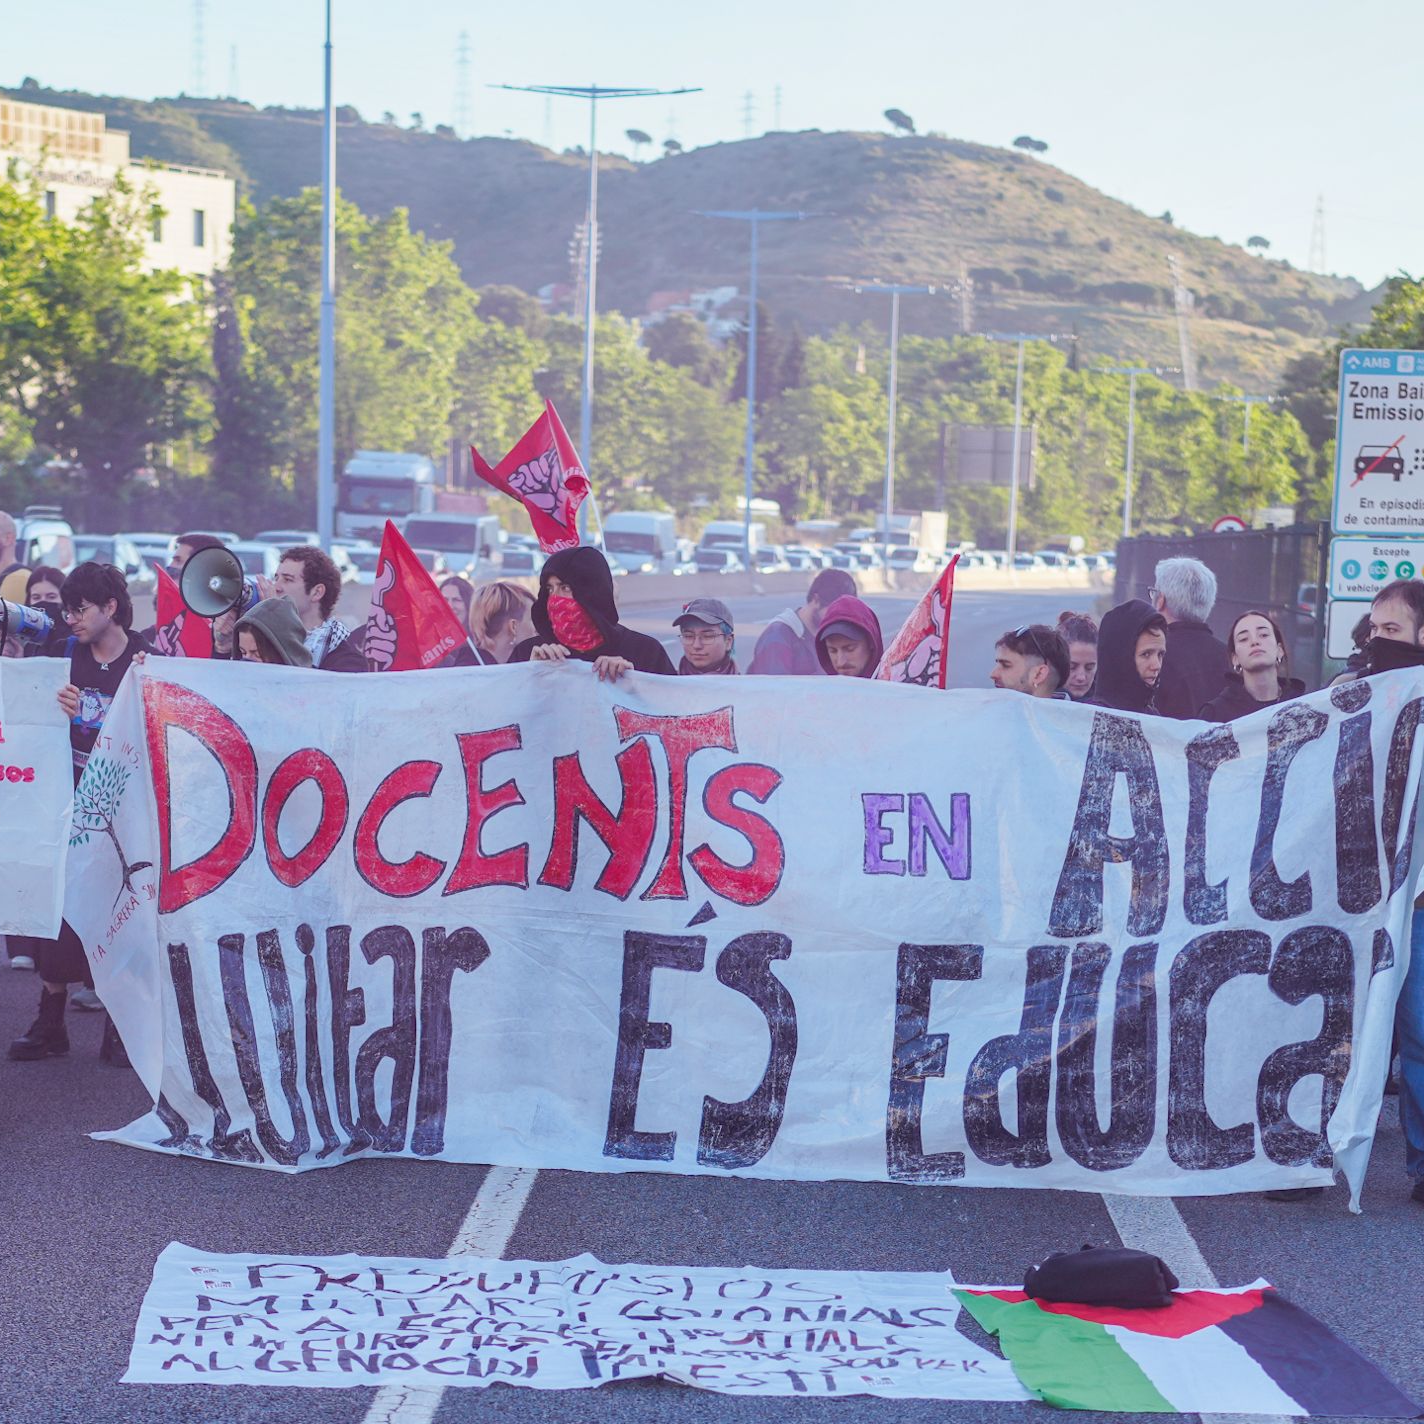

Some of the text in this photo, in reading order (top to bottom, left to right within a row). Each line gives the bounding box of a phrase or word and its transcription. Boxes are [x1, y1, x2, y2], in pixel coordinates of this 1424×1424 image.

[1362, 357, 1391, 368] AMB
[1349, 381, 1389, 399] Zona
[1360, 498, 1374, 509] En
[1344, 514, 1358, 525] de
[1372, 546, 1410, 558] Excepte
[1399, 564, 1411, 576] C
[141, 675, 785, 914] DOCENTS
[861, 792, 972, 880] EN
[602, 900, 798, 1169] ÉS
[295, 1316, 351, 1335] A
[161, 1351, 244, 1373] AL
